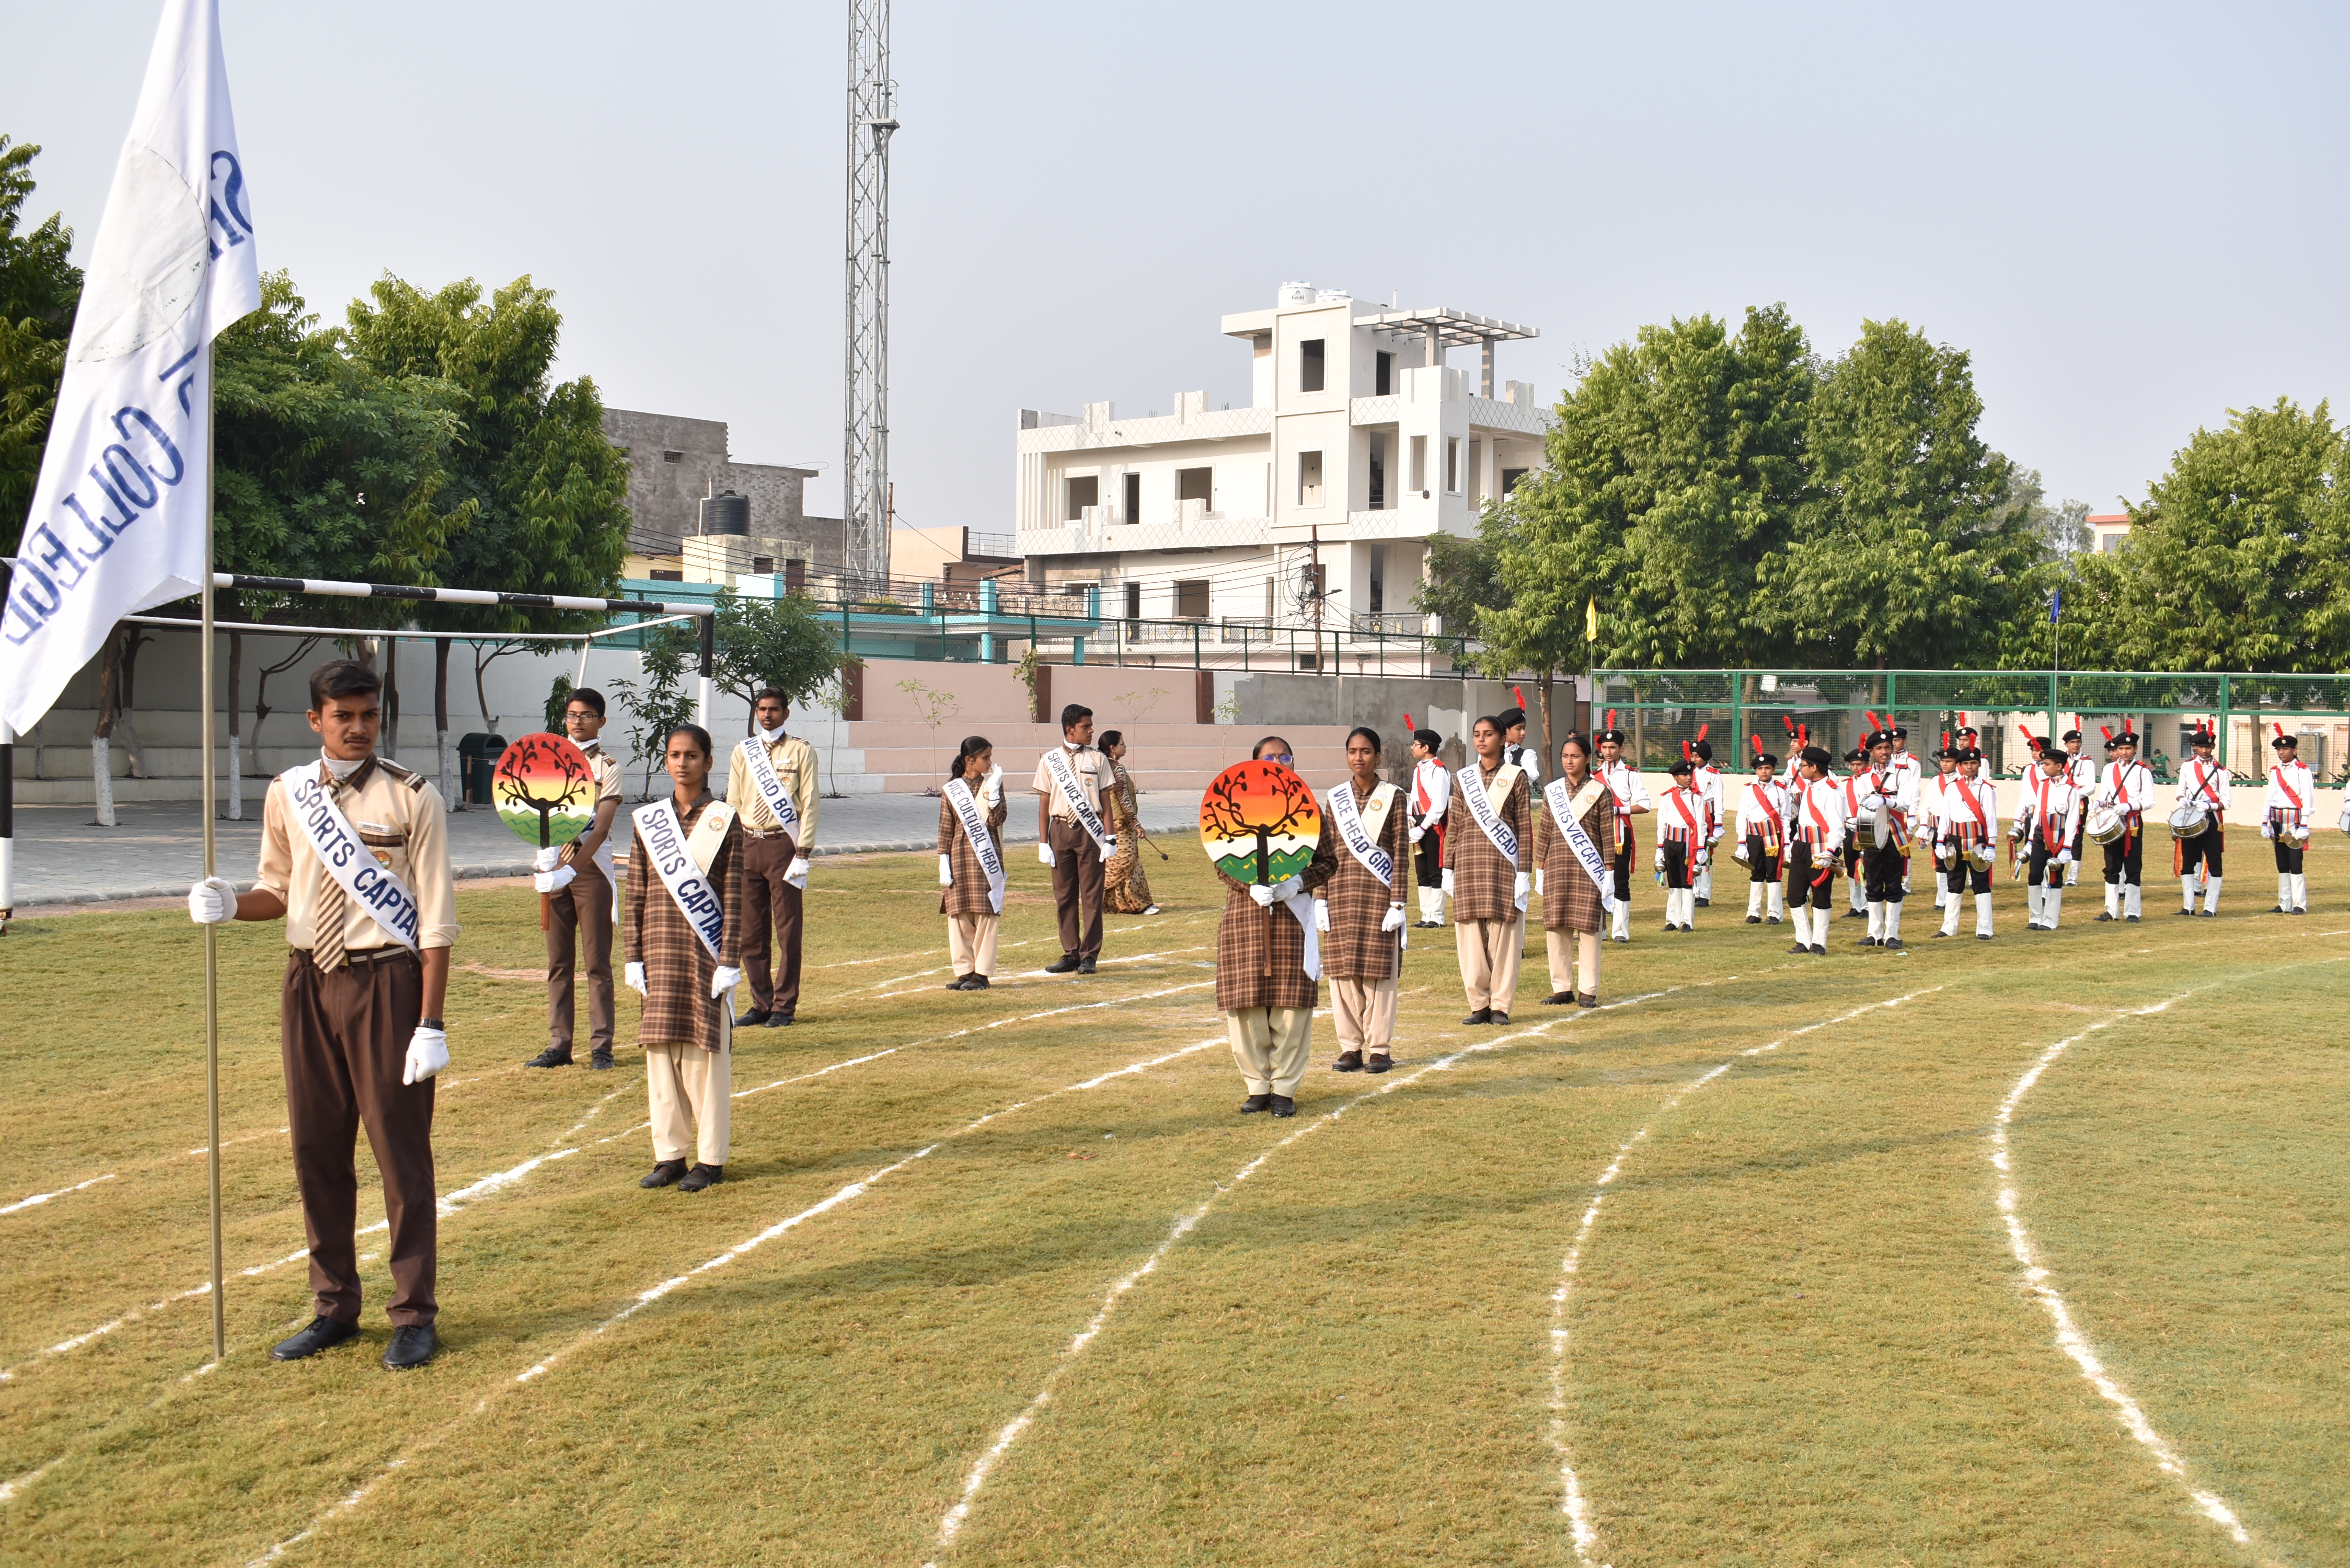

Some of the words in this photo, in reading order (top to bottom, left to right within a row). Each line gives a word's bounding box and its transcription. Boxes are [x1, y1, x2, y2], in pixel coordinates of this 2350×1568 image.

[745, 736, 763, 763] VICE
[754, 760, 779, 797] HEAD
[773, 798, 796, 824] BOY
[1047, 753, 1069, 782] SPORTS
[1064, 781, 1082, 803] VICE
[1076, 802, 1104, 838] CAPTAIN
[1462, 769, 1493, 826] CULTURAL
[1490, 823, 1517, 856] HEAD
[1550, 786, 1572, 823] SPORTS
[1567, 822, 1588, 848] VICE
[295, 778, 355, 867] SPORTS
[354, 868, 419, 949] CAPTAI
[642, 809, 686, 875] SPORTS
[948, 781, 965, 799] VICE
[958, 798, 987, 847] CULTURAL
[980, 847, 999, 875] HEAD
[1333, 788, 1352, 817] VICE
[1343, 818, 1369, 854] HEAD
[1368, 851, 1393, 882] GIRL
